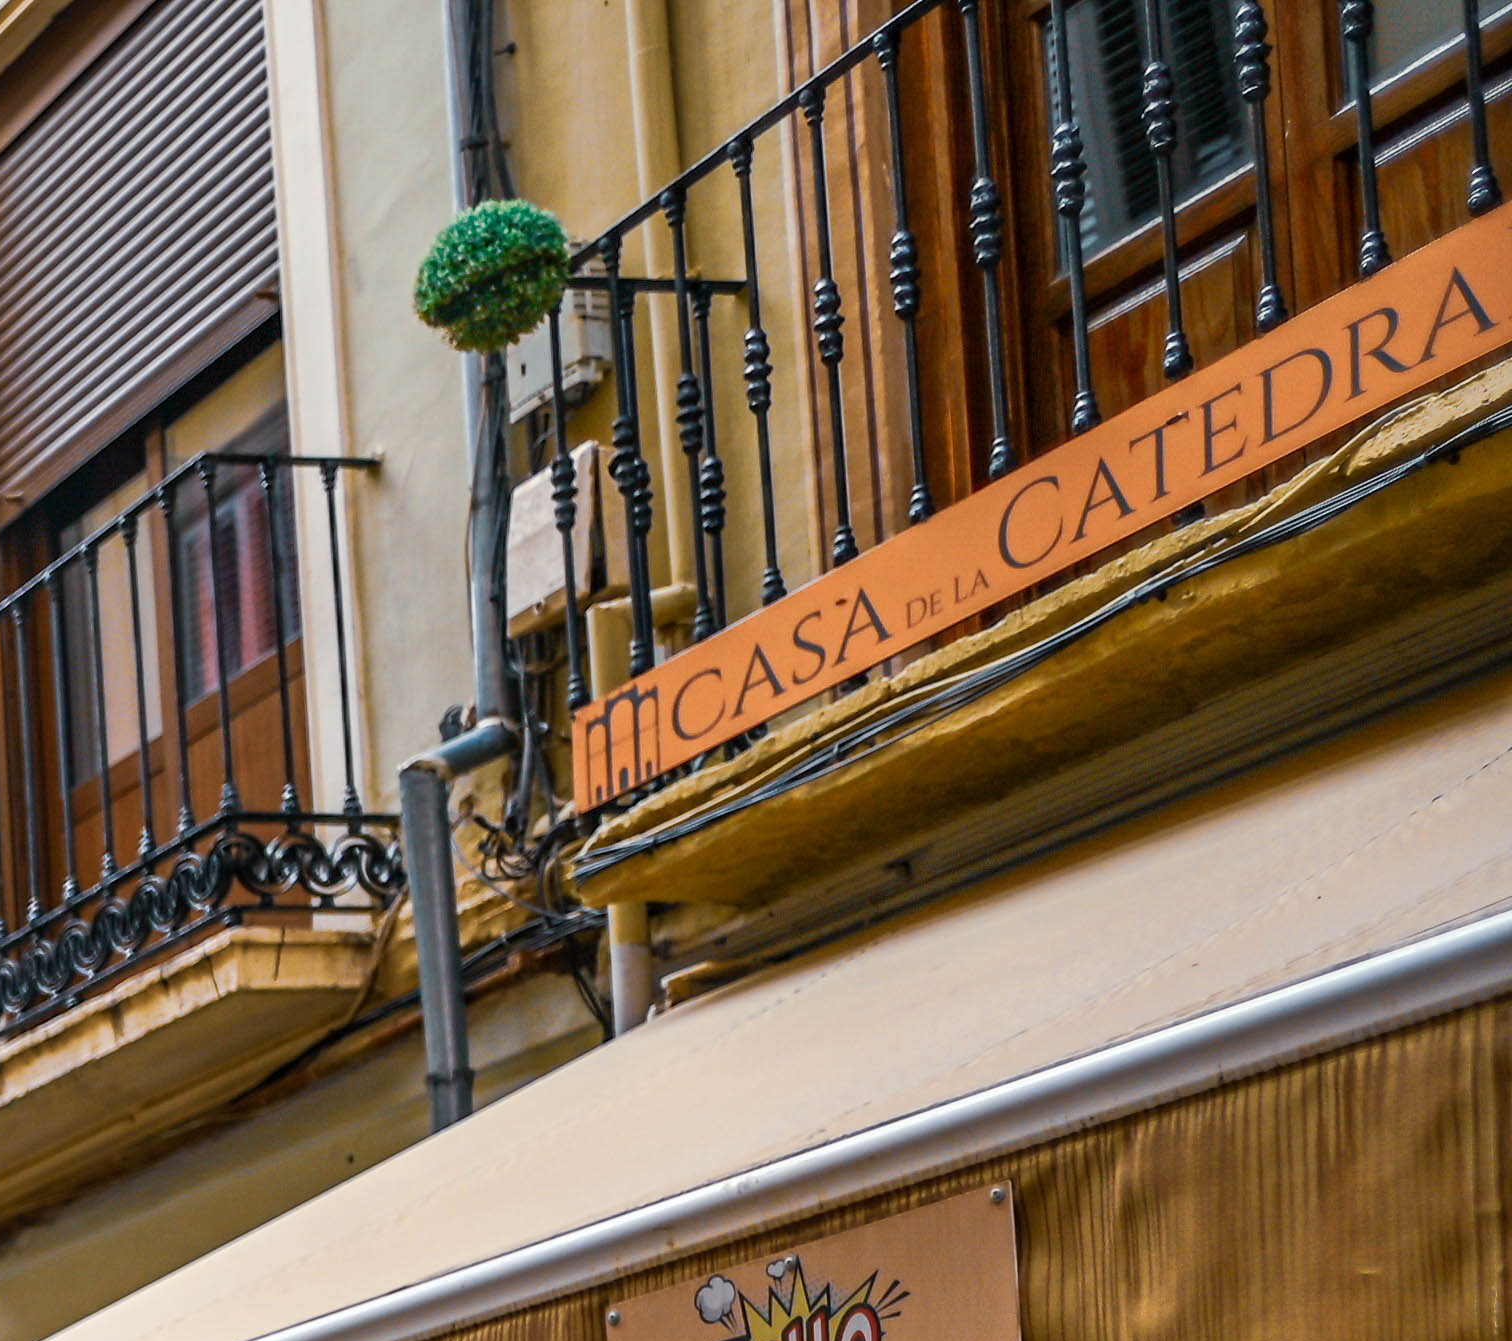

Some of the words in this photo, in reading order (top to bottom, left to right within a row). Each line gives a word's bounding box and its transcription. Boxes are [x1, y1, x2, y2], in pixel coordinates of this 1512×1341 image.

[671, 586, 890, 740] CASA
[906, 596, 943, 629] DE
[953, 569, 991, 607] LA
[998, 227, 1512, 570] CATEDRA
